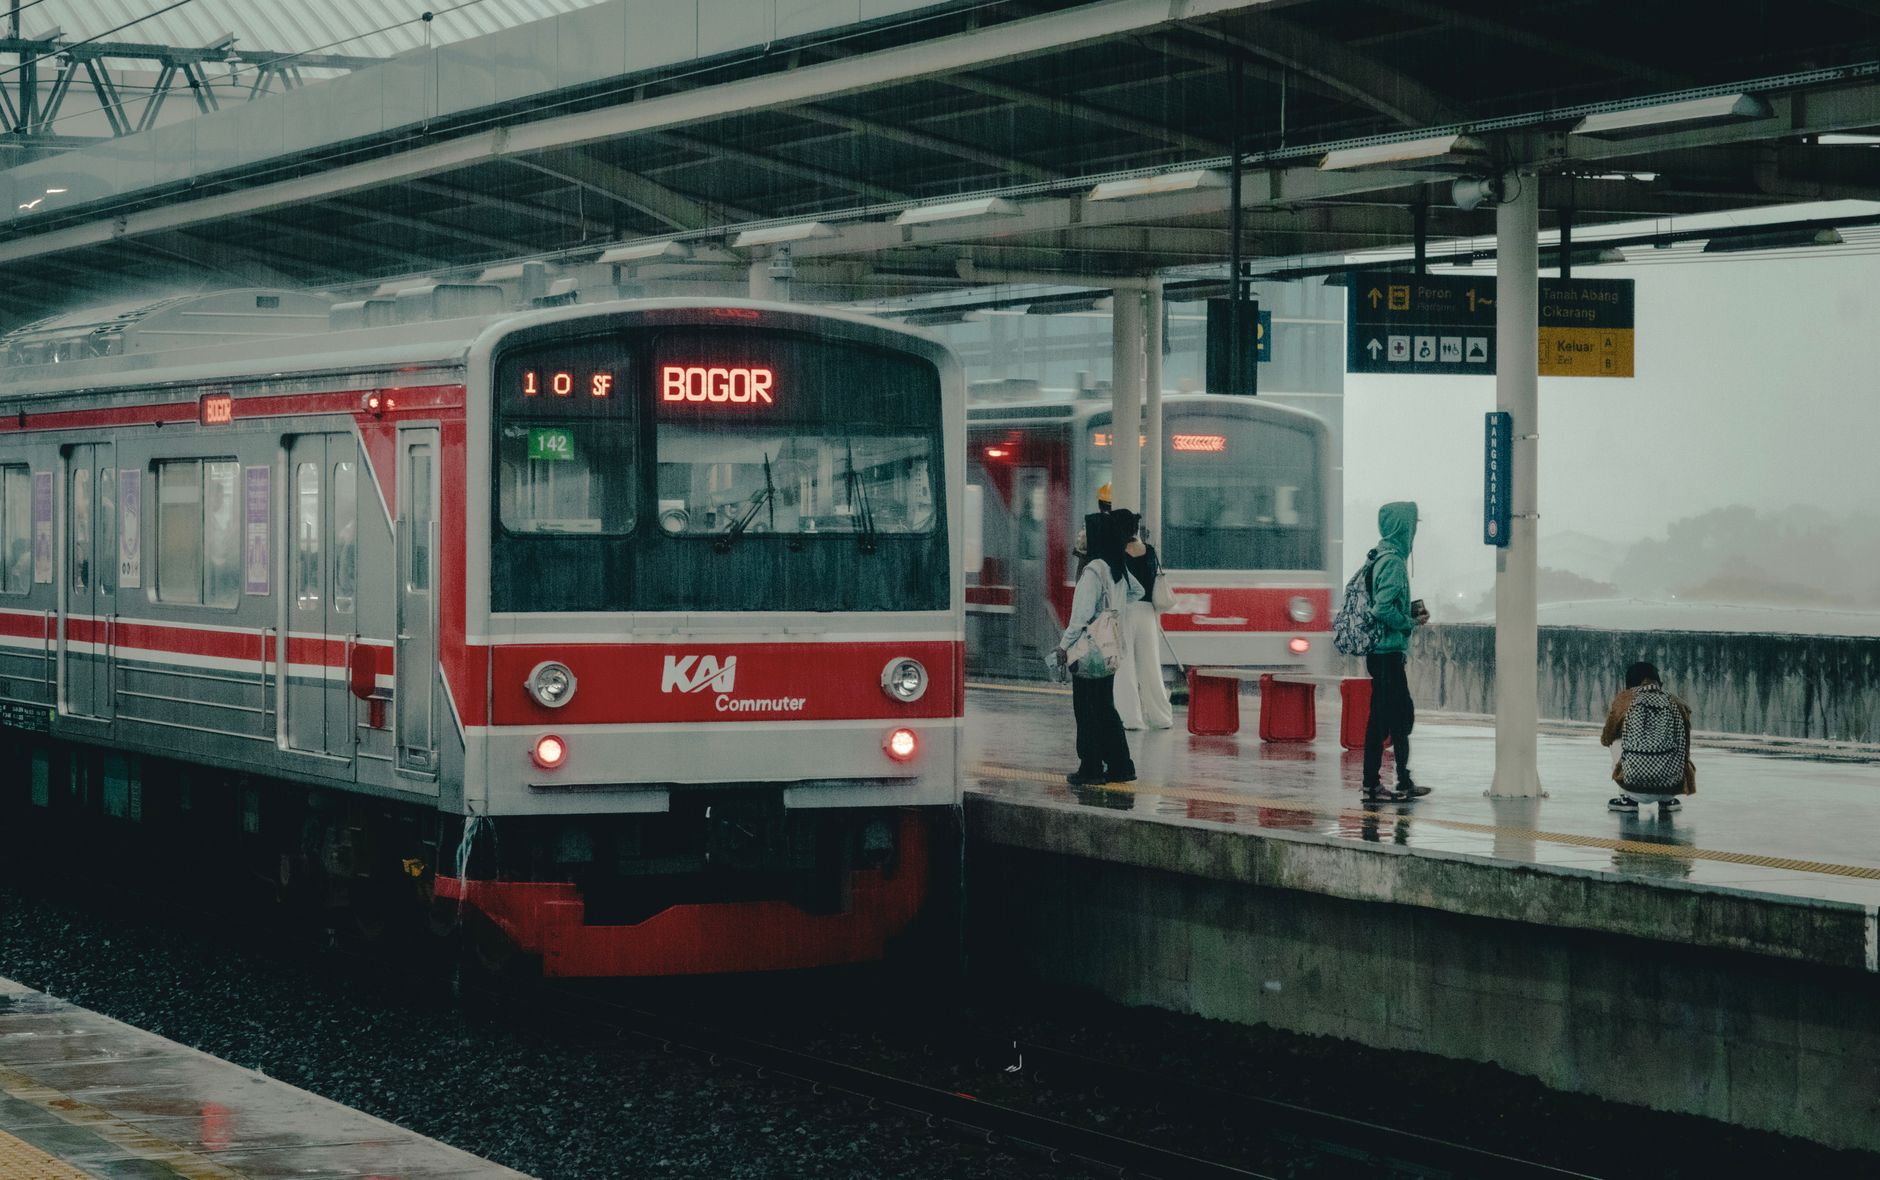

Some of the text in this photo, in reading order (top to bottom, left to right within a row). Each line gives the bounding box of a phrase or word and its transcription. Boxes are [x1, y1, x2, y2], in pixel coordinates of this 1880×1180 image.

[1418, 286, 1452, 298] Peron
[1543, 288, 1618, 304] Tanah Abang
[1543, 305, 1596, 321] Cikarang
[1557, 338, 1612, 352] Keluar A
[592, 375, 612, 396] SF
[663, 366, 773, 404] BOGOR
[538, 435, 567, 452] 142
[1490, 415, 1498, 515] MANGGARAI
[661, 654, 737, 693] KAI
[715, 694, 806, 712] Commuter
